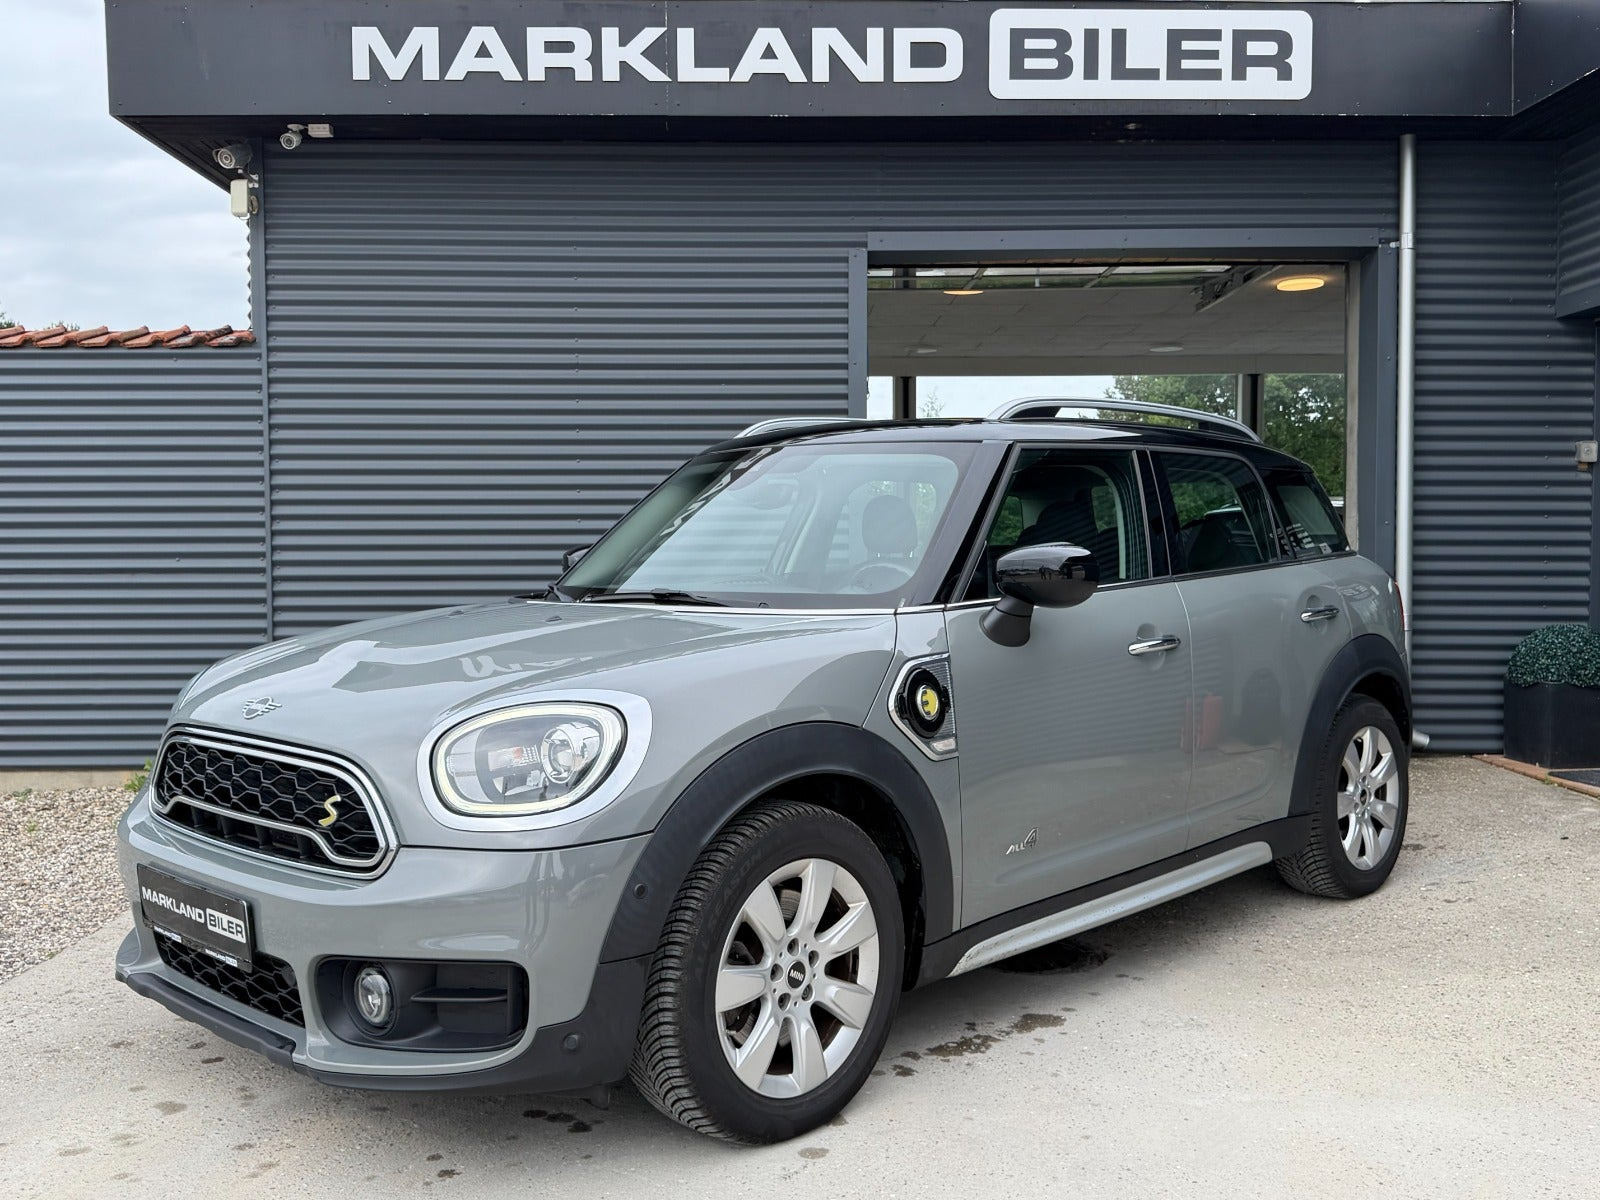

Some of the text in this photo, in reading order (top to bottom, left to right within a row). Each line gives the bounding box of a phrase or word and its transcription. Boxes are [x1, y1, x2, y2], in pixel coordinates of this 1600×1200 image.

[351, 26, 1293, 82] MARKLAND BILER
[318, 795, 341, 826] S
[141, 886, 205, 923] MARKLAND
[208, 912, 244, 939] BILER
